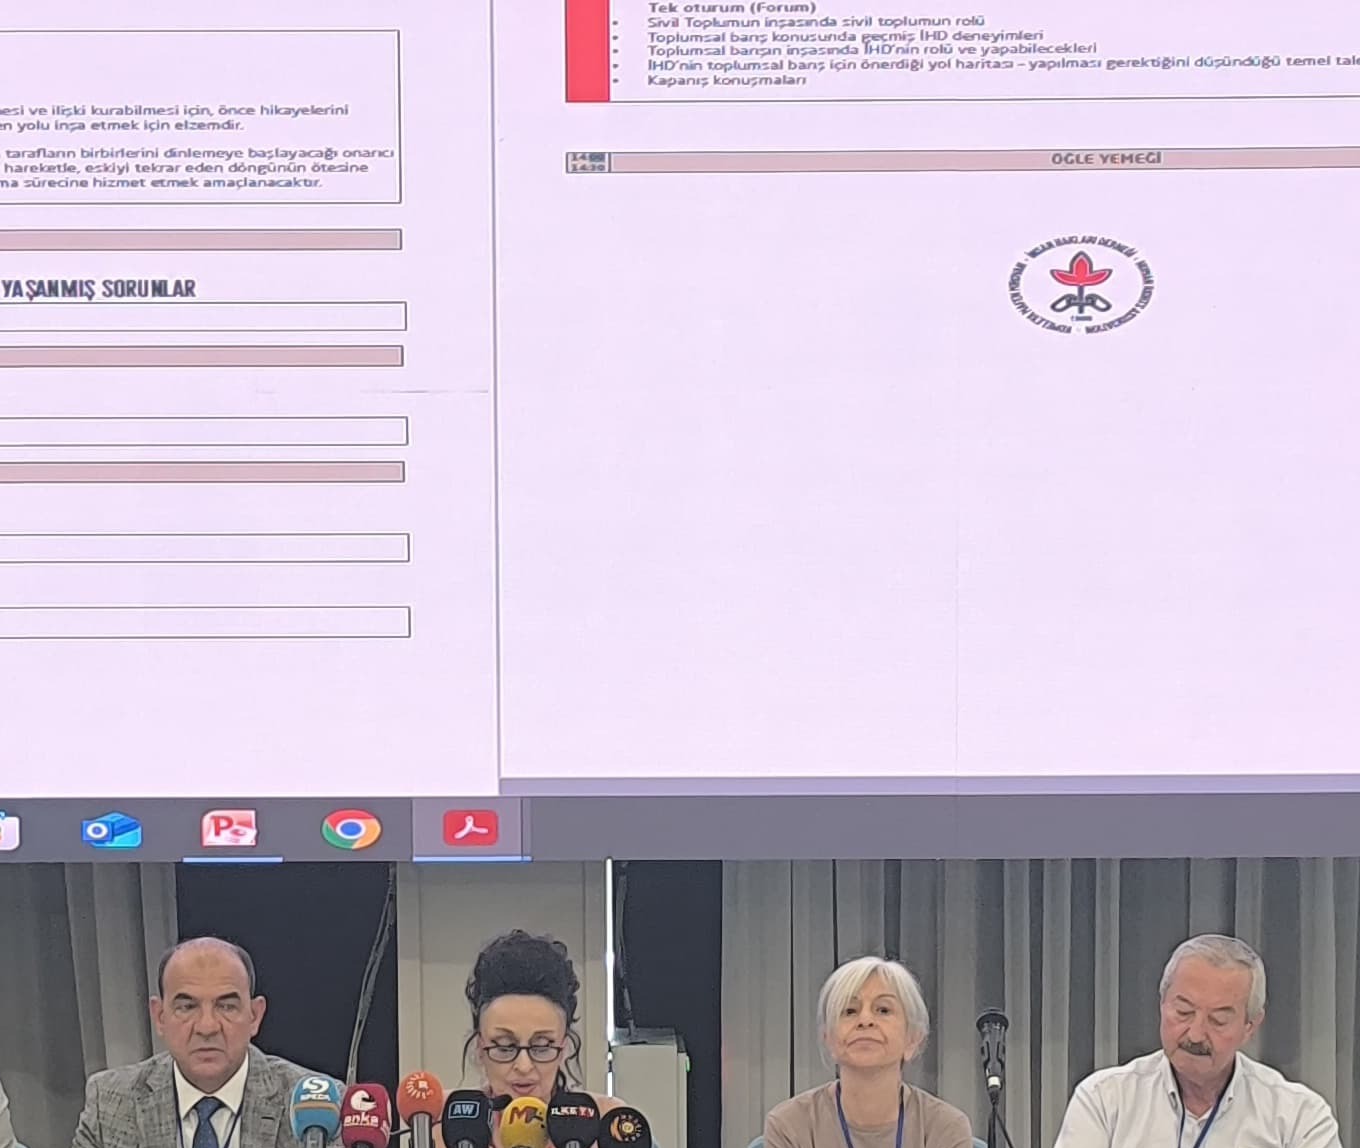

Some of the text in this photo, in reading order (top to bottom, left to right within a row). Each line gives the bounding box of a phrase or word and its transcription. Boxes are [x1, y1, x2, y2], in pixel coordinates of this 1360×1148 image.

[0, 280, 97, 300] YAŞANMIŞ
[101, 280, 197, 298] SORUNLAR
[344, 1112, 379, 1127] anka
